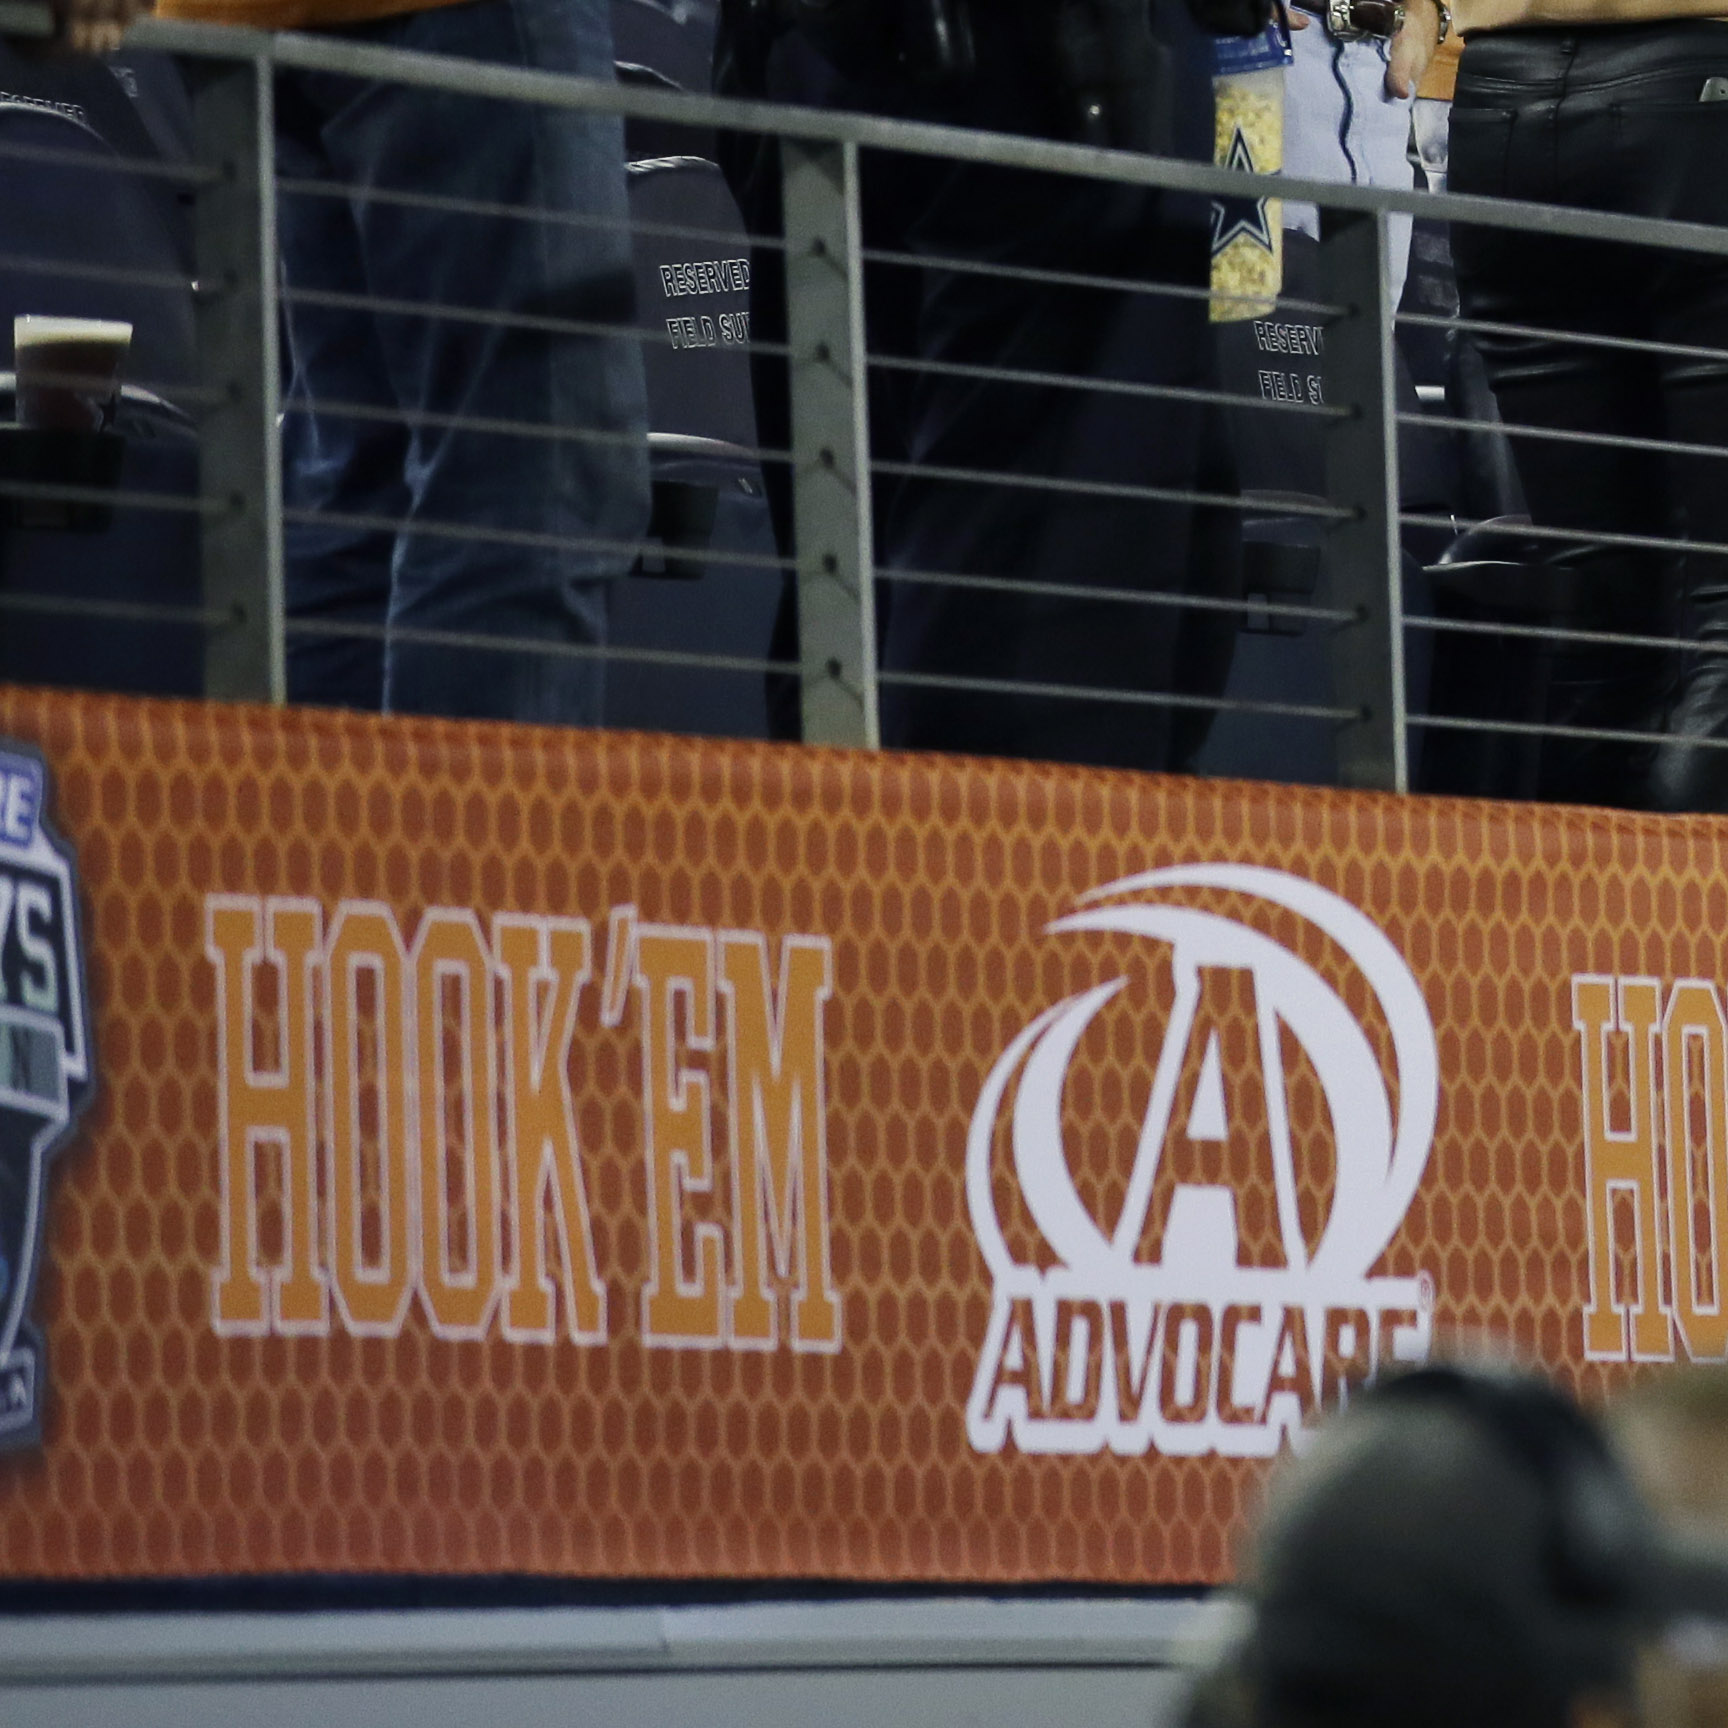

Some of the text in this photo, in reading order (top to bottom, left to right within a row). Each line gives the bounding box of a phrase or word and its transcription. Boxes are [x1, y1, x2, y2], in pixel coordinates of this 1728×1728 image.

[659, 258, 750, 297] RESERVED
[665, 316, 717, 349] FIELD
[1253, 320, 1325, 355] RESERV
[1258, 369, 1304, 403] FIELD
[205, 892, 842, 1353] HOOK'EM
